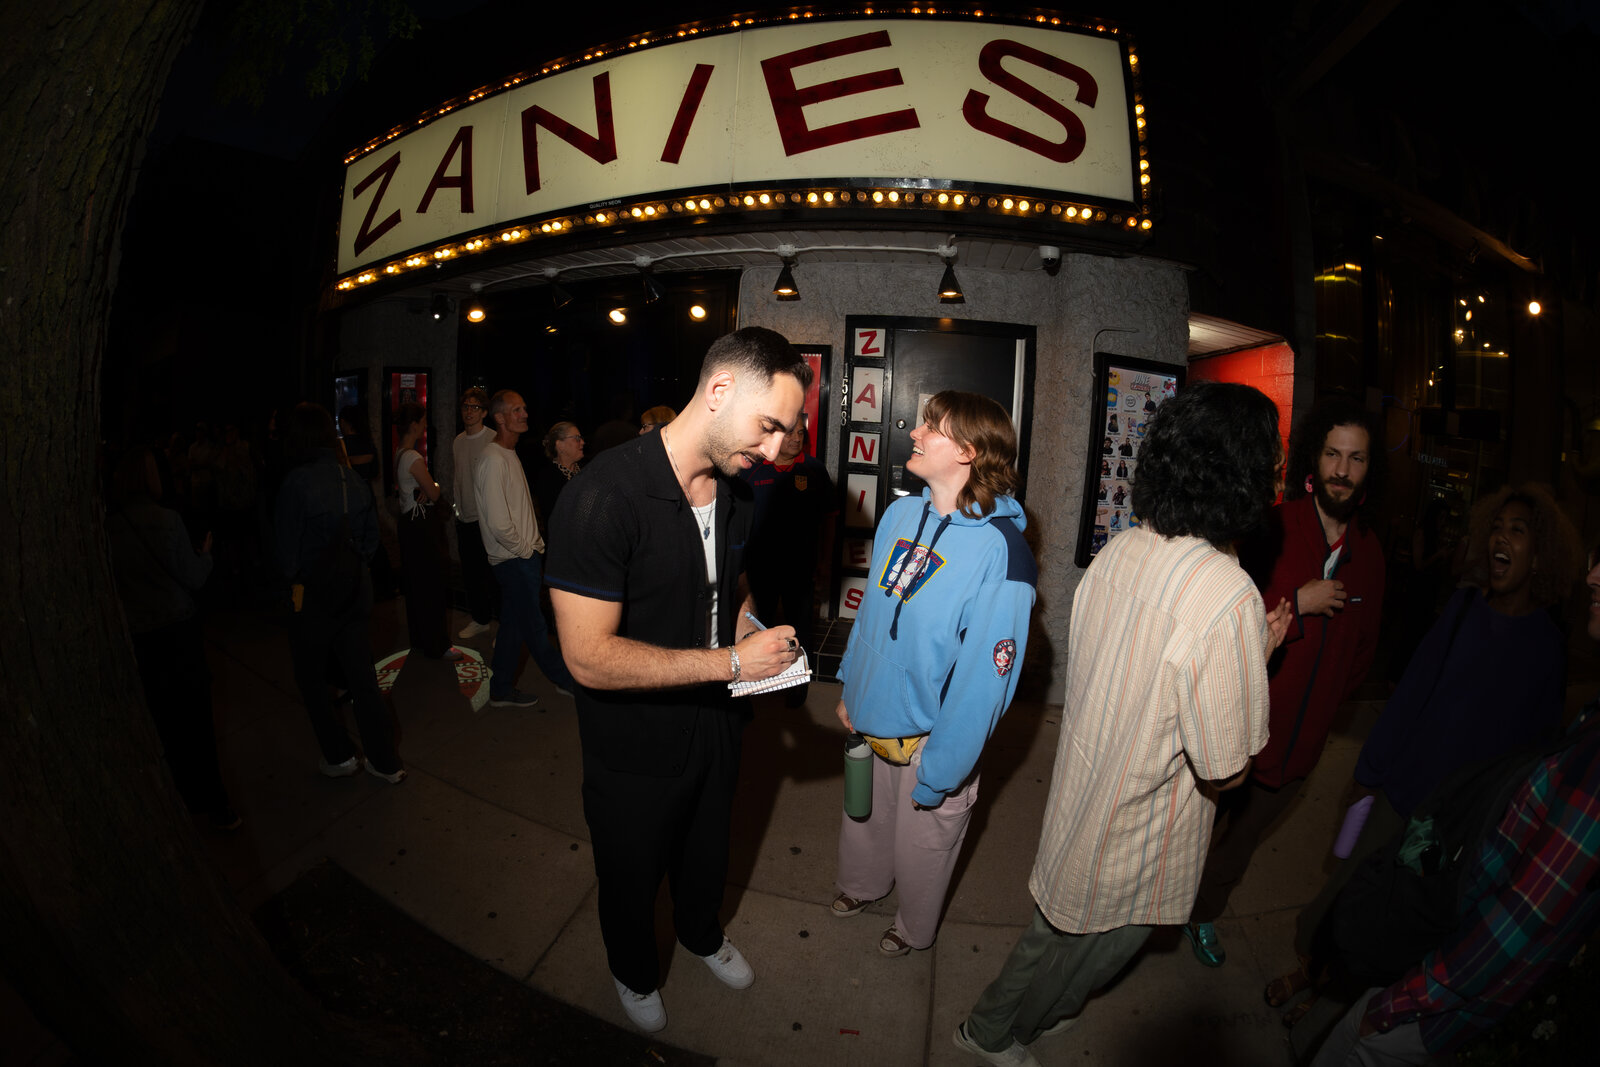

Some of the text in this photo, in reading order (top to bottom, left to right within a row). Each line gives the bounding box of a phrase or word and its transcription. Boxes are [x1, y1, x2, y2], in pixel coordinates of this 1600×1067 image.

[352, 29, 1099, 257] ZANIES
[840, 362, 849, 426] 1548
[844, 330, 880, 610] ZANIES
